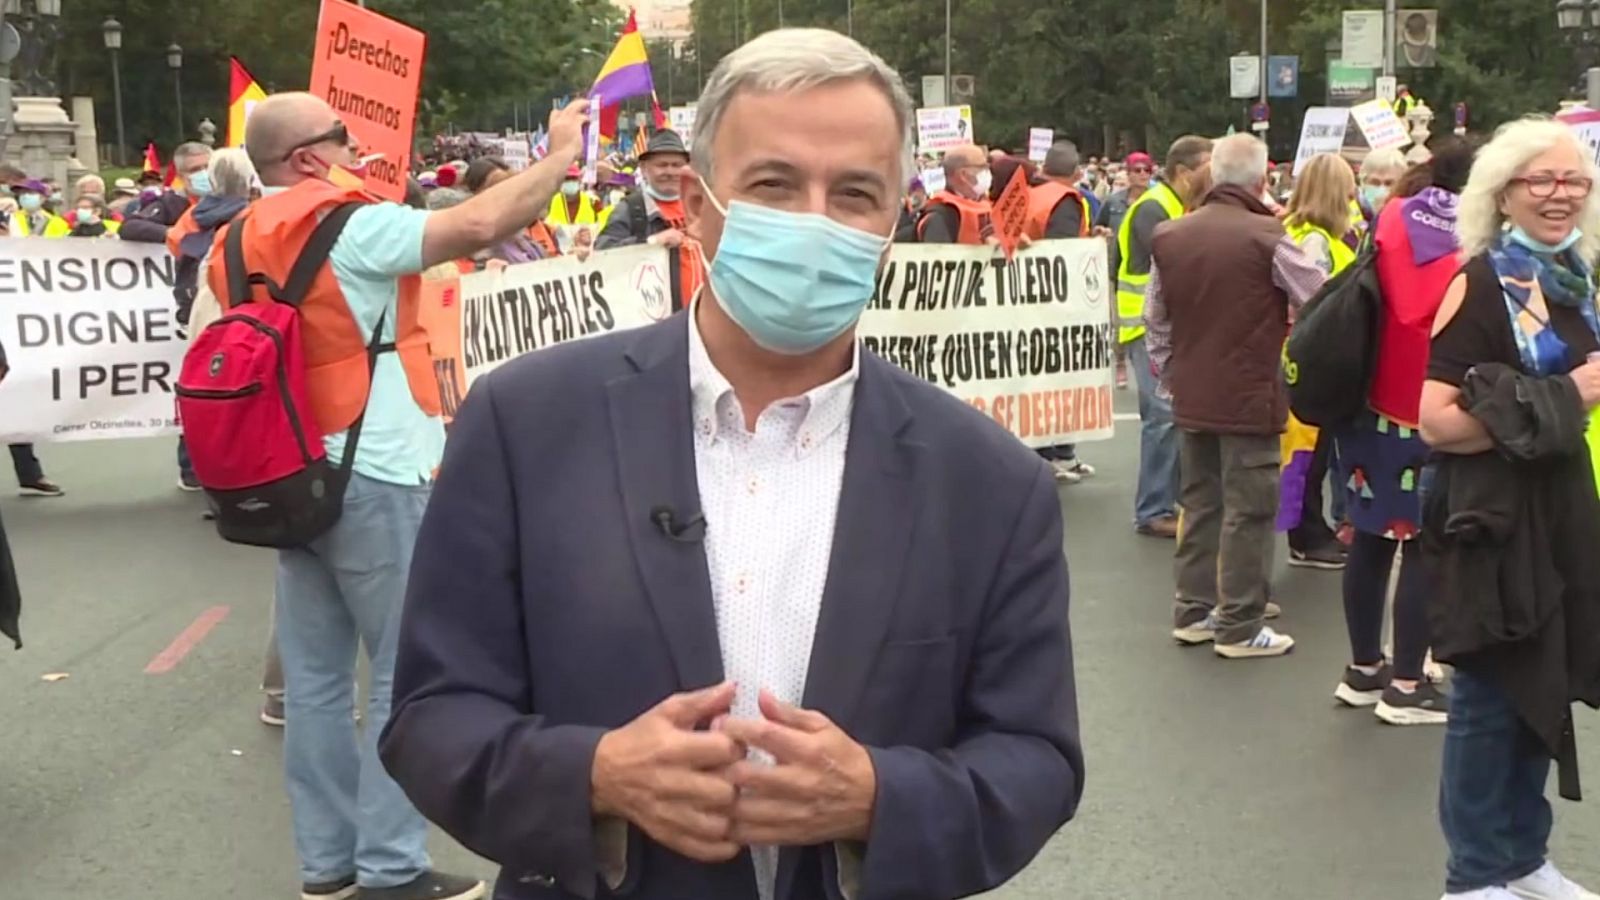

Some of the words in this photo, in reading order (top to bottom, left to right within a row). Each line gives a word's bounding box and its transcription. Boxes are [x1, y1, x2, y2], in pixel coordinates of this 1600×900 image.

[326, 22, 410, 78] ¡Derechos
[327, 75, 401, 130] humanos
[532, 279, 574, 346] PER
[569, 270, 615, 335] LES
[898, 259, 966, 311] PACTO
[990, 254, 1068, 306] TOLEDO
[52, 367, 60, 401] I
[941, 330, 1012, 388] QUIEN
